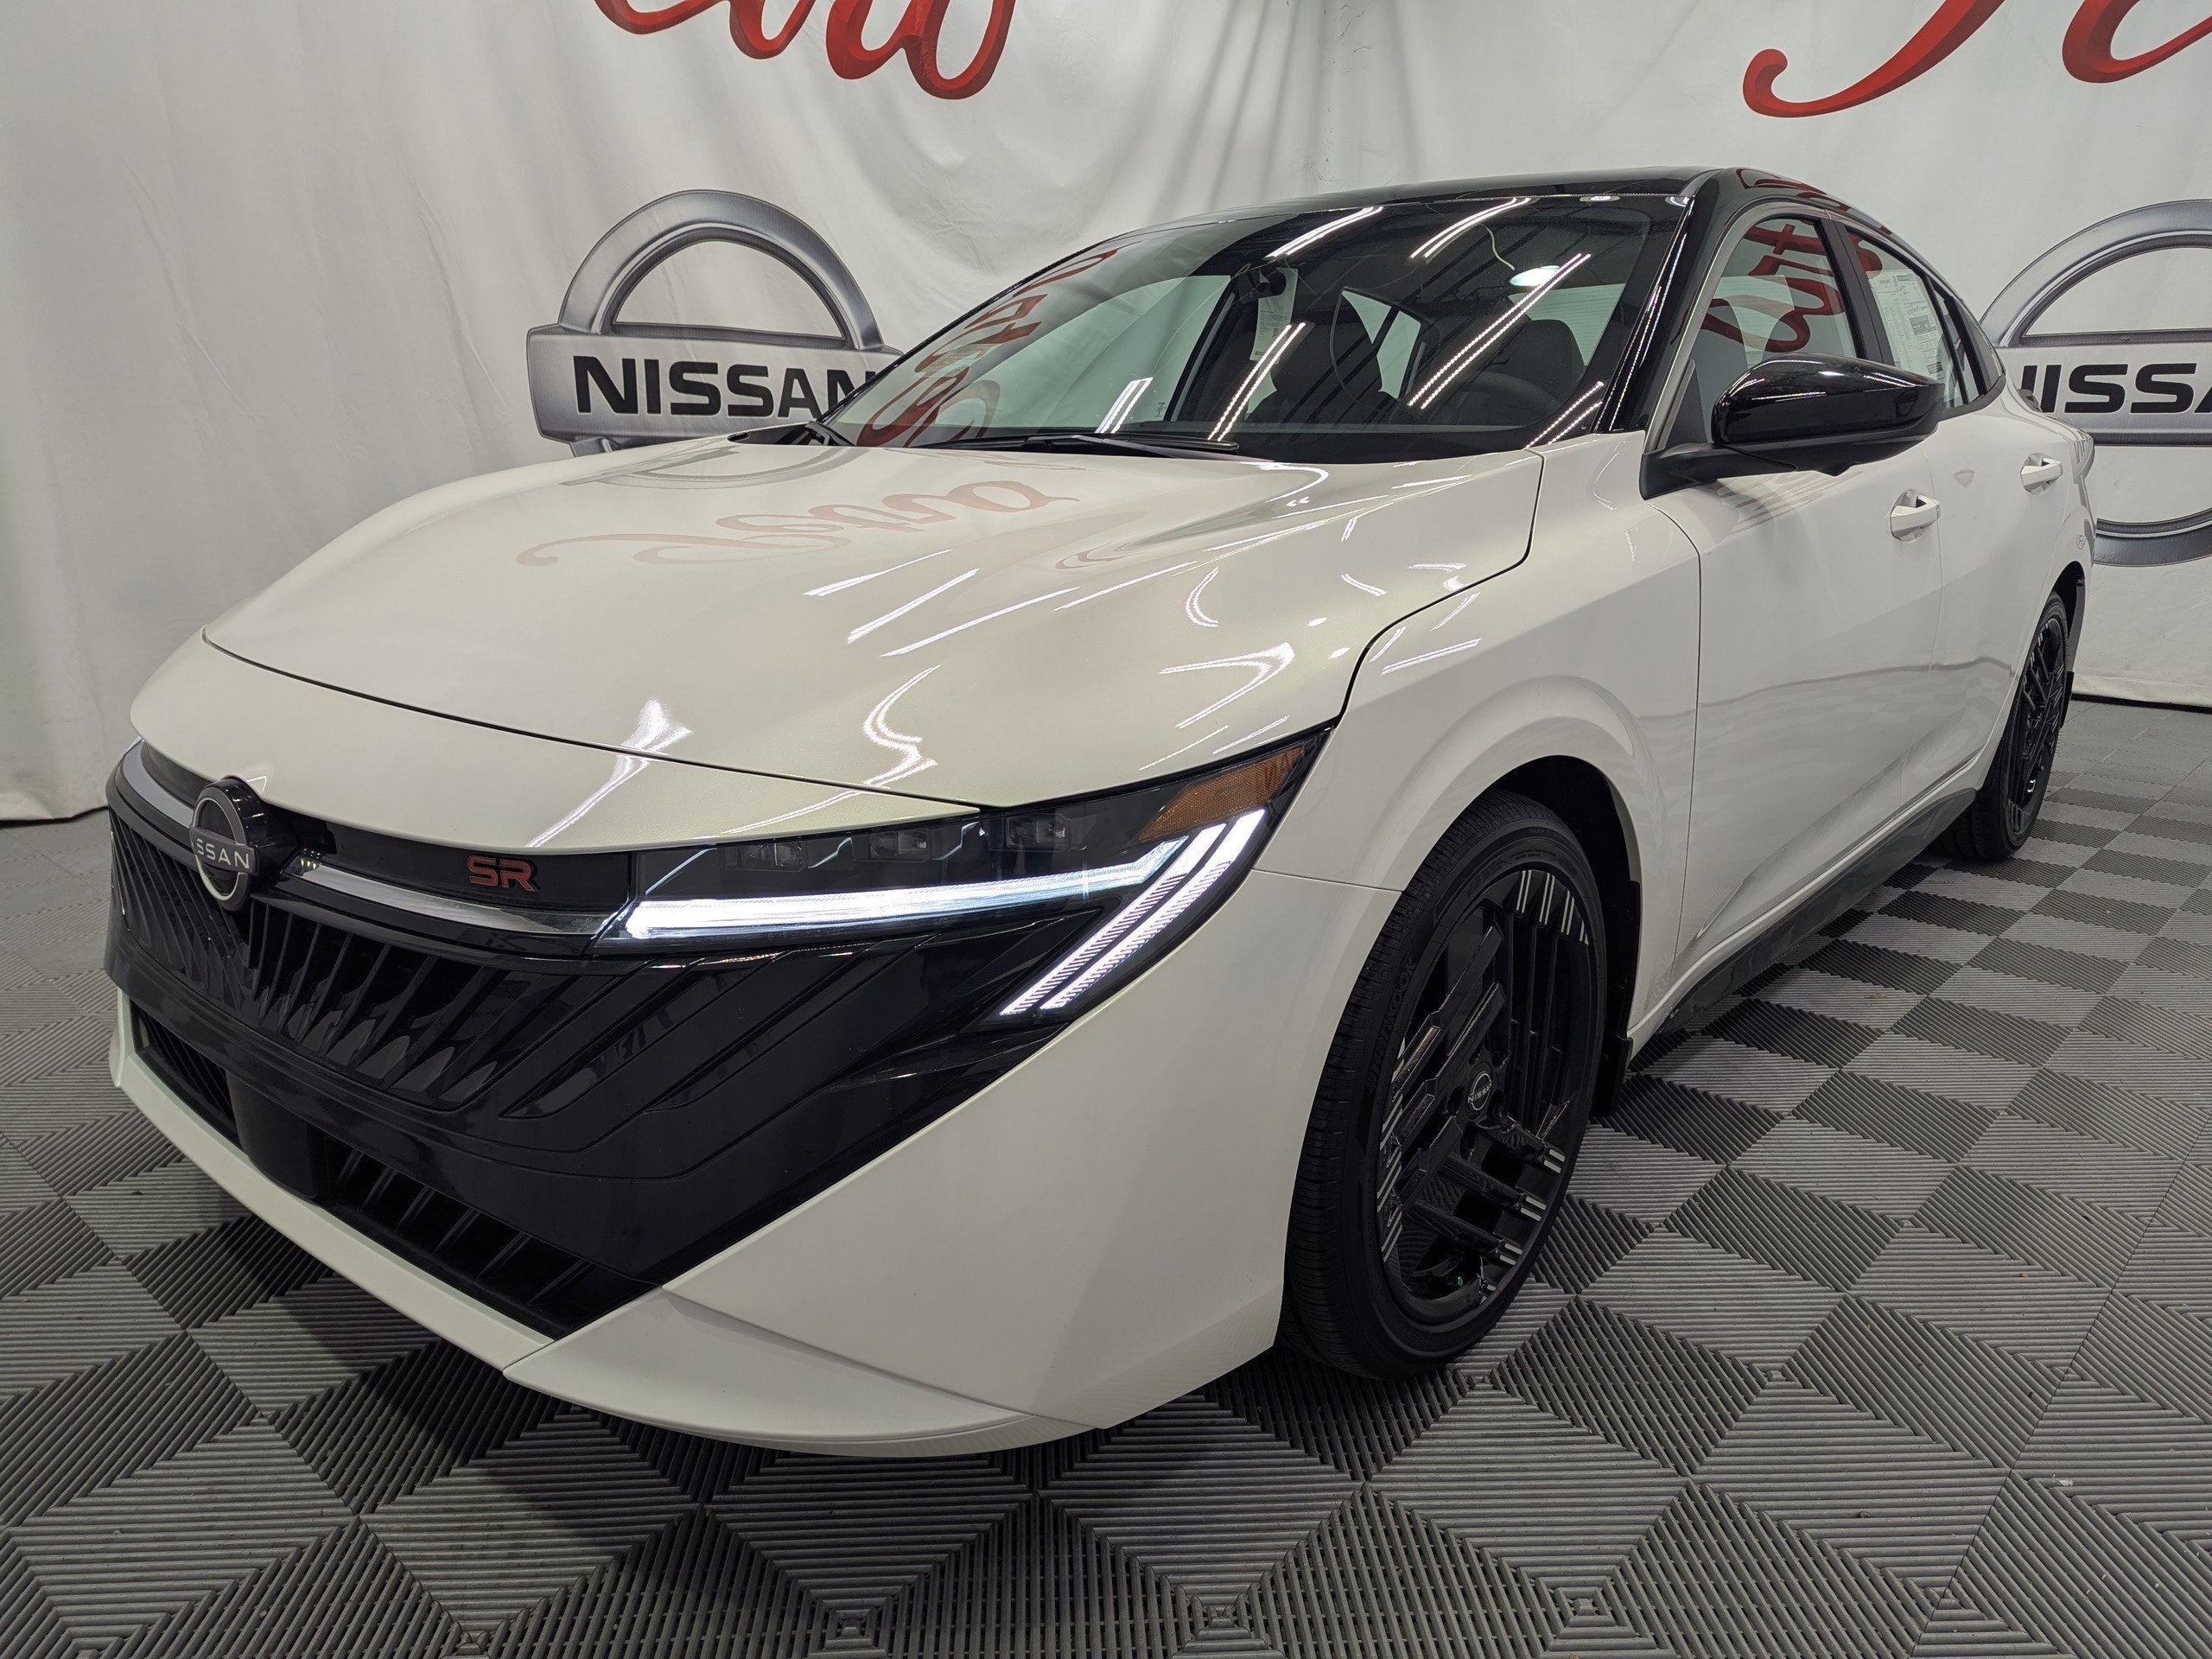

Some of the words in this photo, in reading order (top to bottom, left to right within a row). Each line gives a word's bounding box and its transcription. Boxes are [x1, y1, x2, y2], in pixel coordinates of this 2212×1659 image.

[573, 355, 876, 419] NISSAN
[2021, 363, 2212, 414] ISS
[193, 837, 250, 869] SSAN
[467, 855, 536, 892] SR
